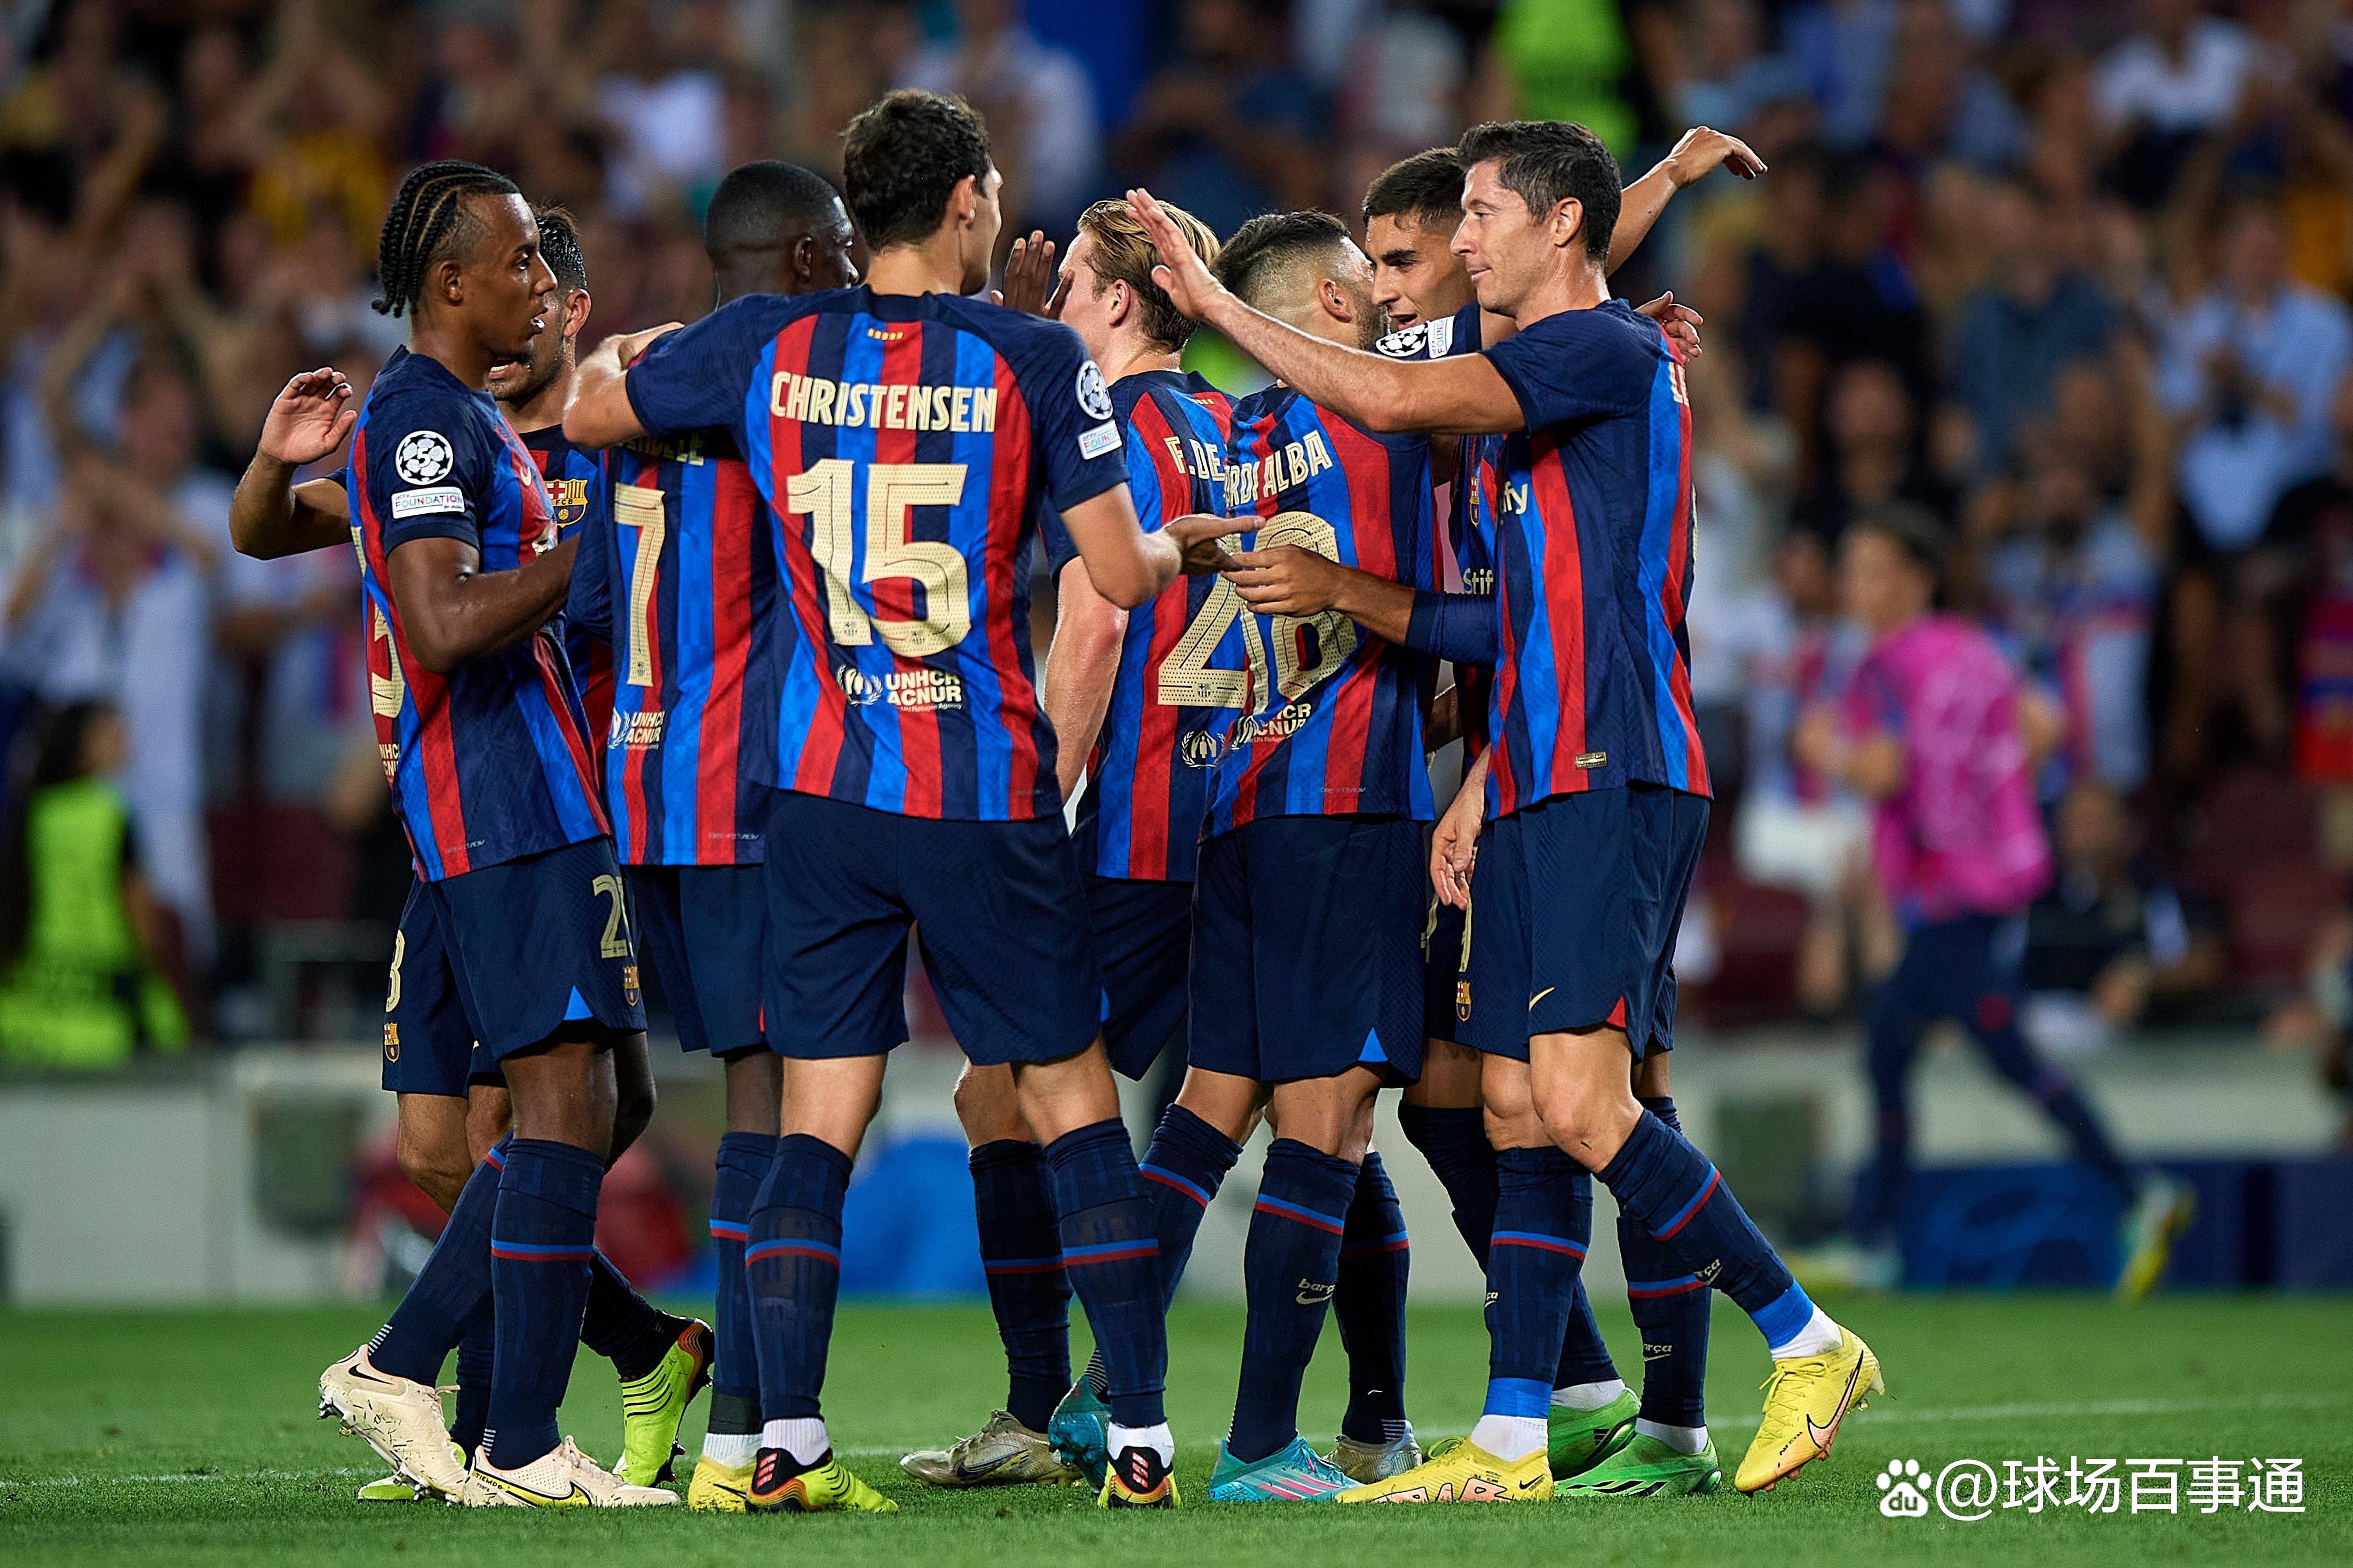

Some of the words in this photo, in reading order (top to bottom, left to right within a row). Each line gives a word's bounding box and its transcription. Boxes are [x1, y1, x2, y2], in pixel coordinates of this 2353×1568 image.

[1436, 320, 1445, 354] FOUND
[770, 371, 997, 433] CHRISTENSEN
[1263, 429, 1333, 499] ALBA
[395, 495, 463, 510] FOUNDATION
[787, 458, 971, 657] 15
[615, 482, 666, 687] 7
[885, 669, 961, 690] UNHCR
[887, 685, 962, 706] ACNUR
[625, 727, 662, 743] ACNUR
[592, 874, 635, 959] 2
[475, 1473, 503, 1490] TIEMPO
